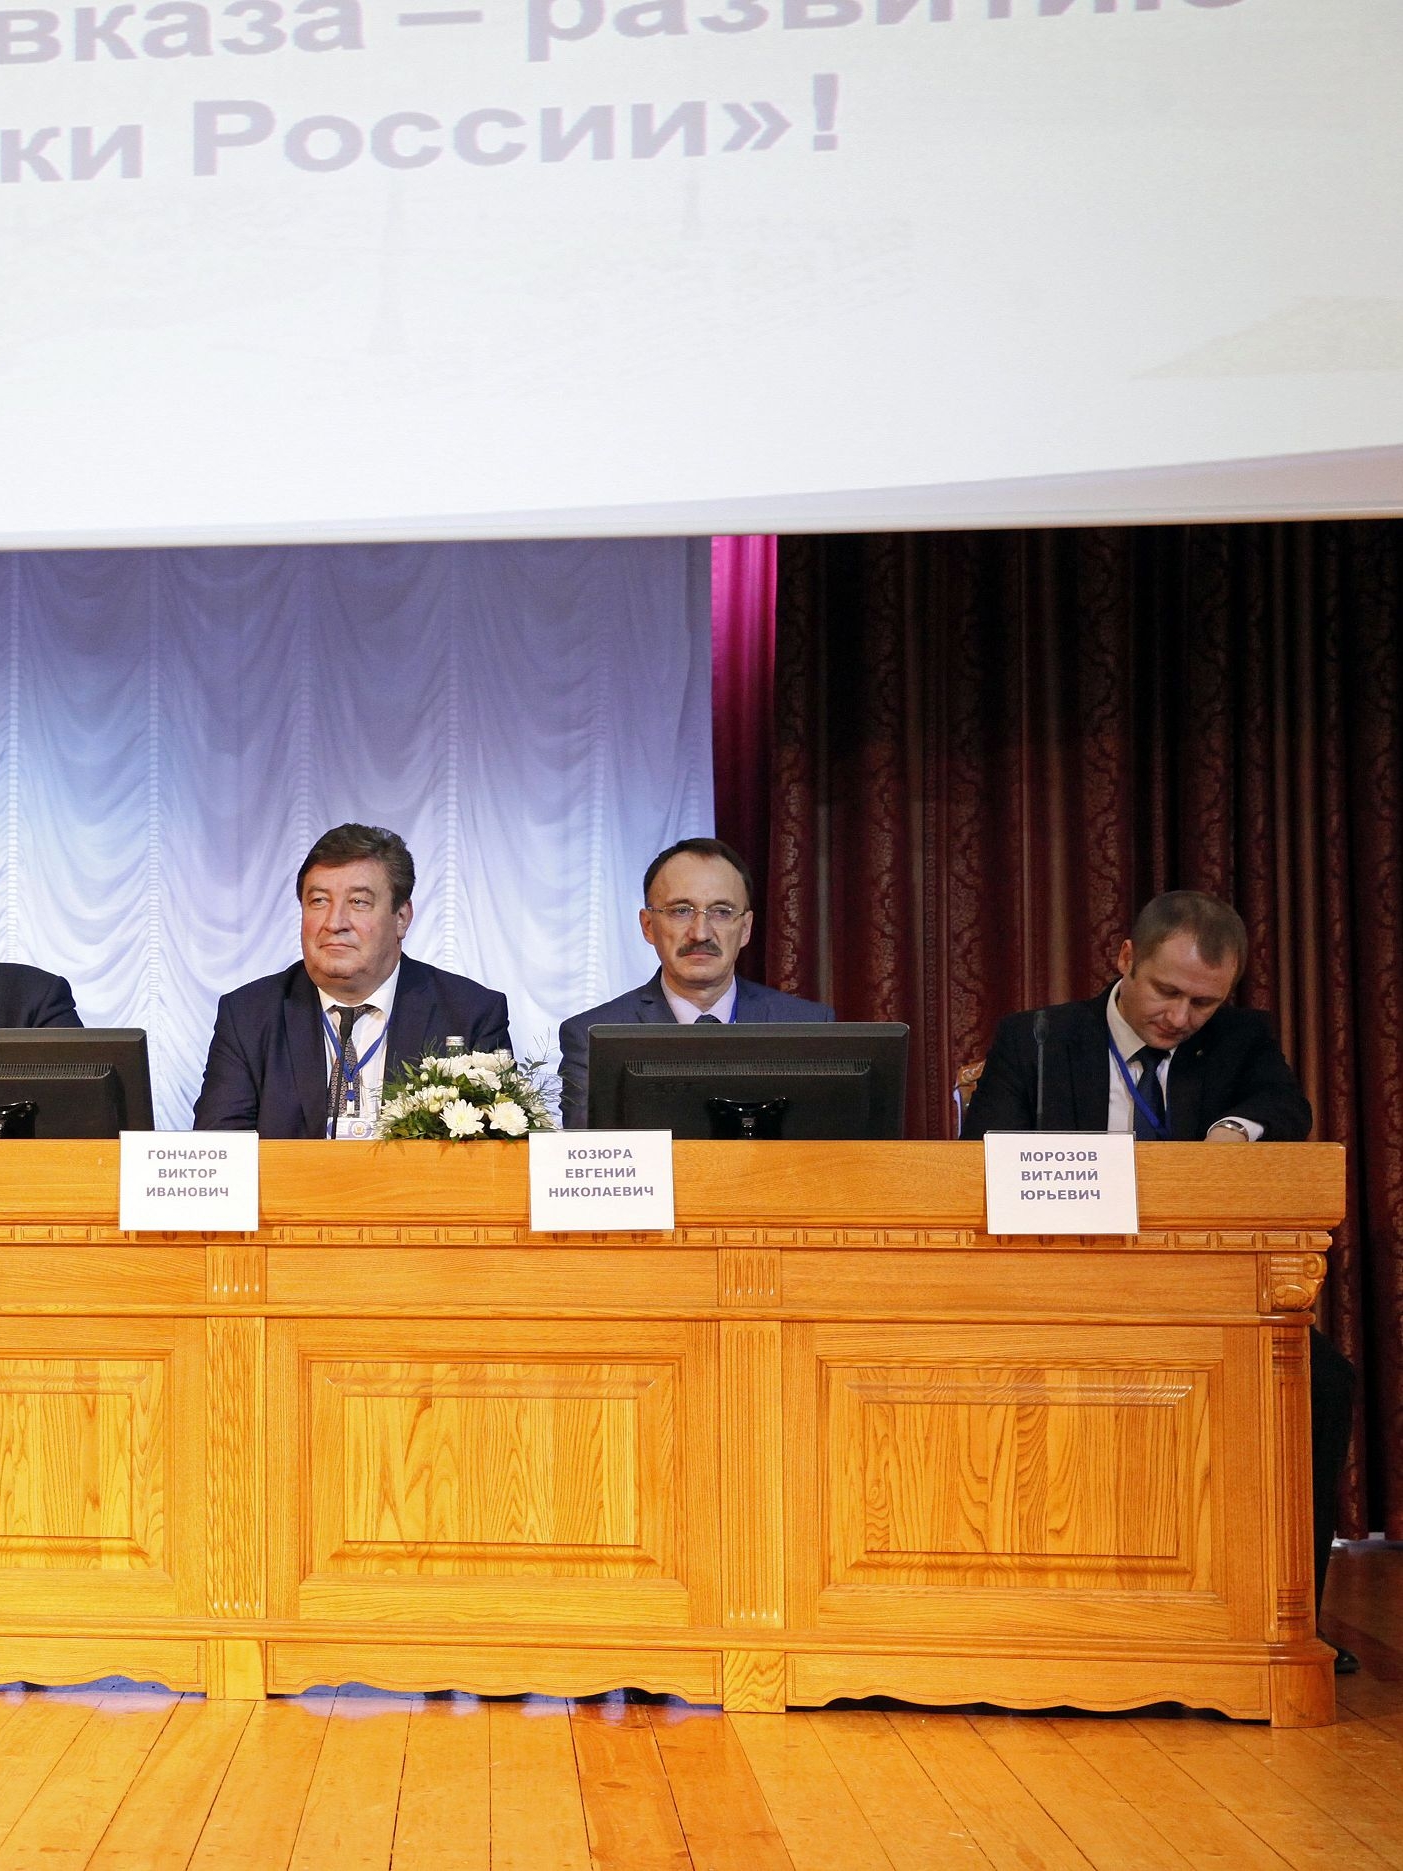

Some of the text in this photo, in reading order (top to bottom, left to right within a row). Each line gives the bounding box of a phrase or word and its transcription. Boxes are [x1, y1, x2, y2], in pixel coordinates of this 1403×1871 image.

[193, 71, 840, 177] России»!
[147, 1149, 228, 1160] ГОНЧАРОВ
[567, 1148, 633, 1160] КОЗЮРА
[1019, 1151, 1098, 1162] МОРОЗОВ
[158, 1167, 217, 1179] ВИКТОР
[565, 1165, 636, 1179] ЕВГЕНИЙ
[1021, 1168, 1098, 1182] ВИТАЛИЙ
[146, 1186, 229, 1197] ИВАНОВИЧ
[548, 1185, 654, 1198] НИКОЛАЕВИЧ
[1020, 1189, 1101, 1201] ЮРЬЕВИЧ
